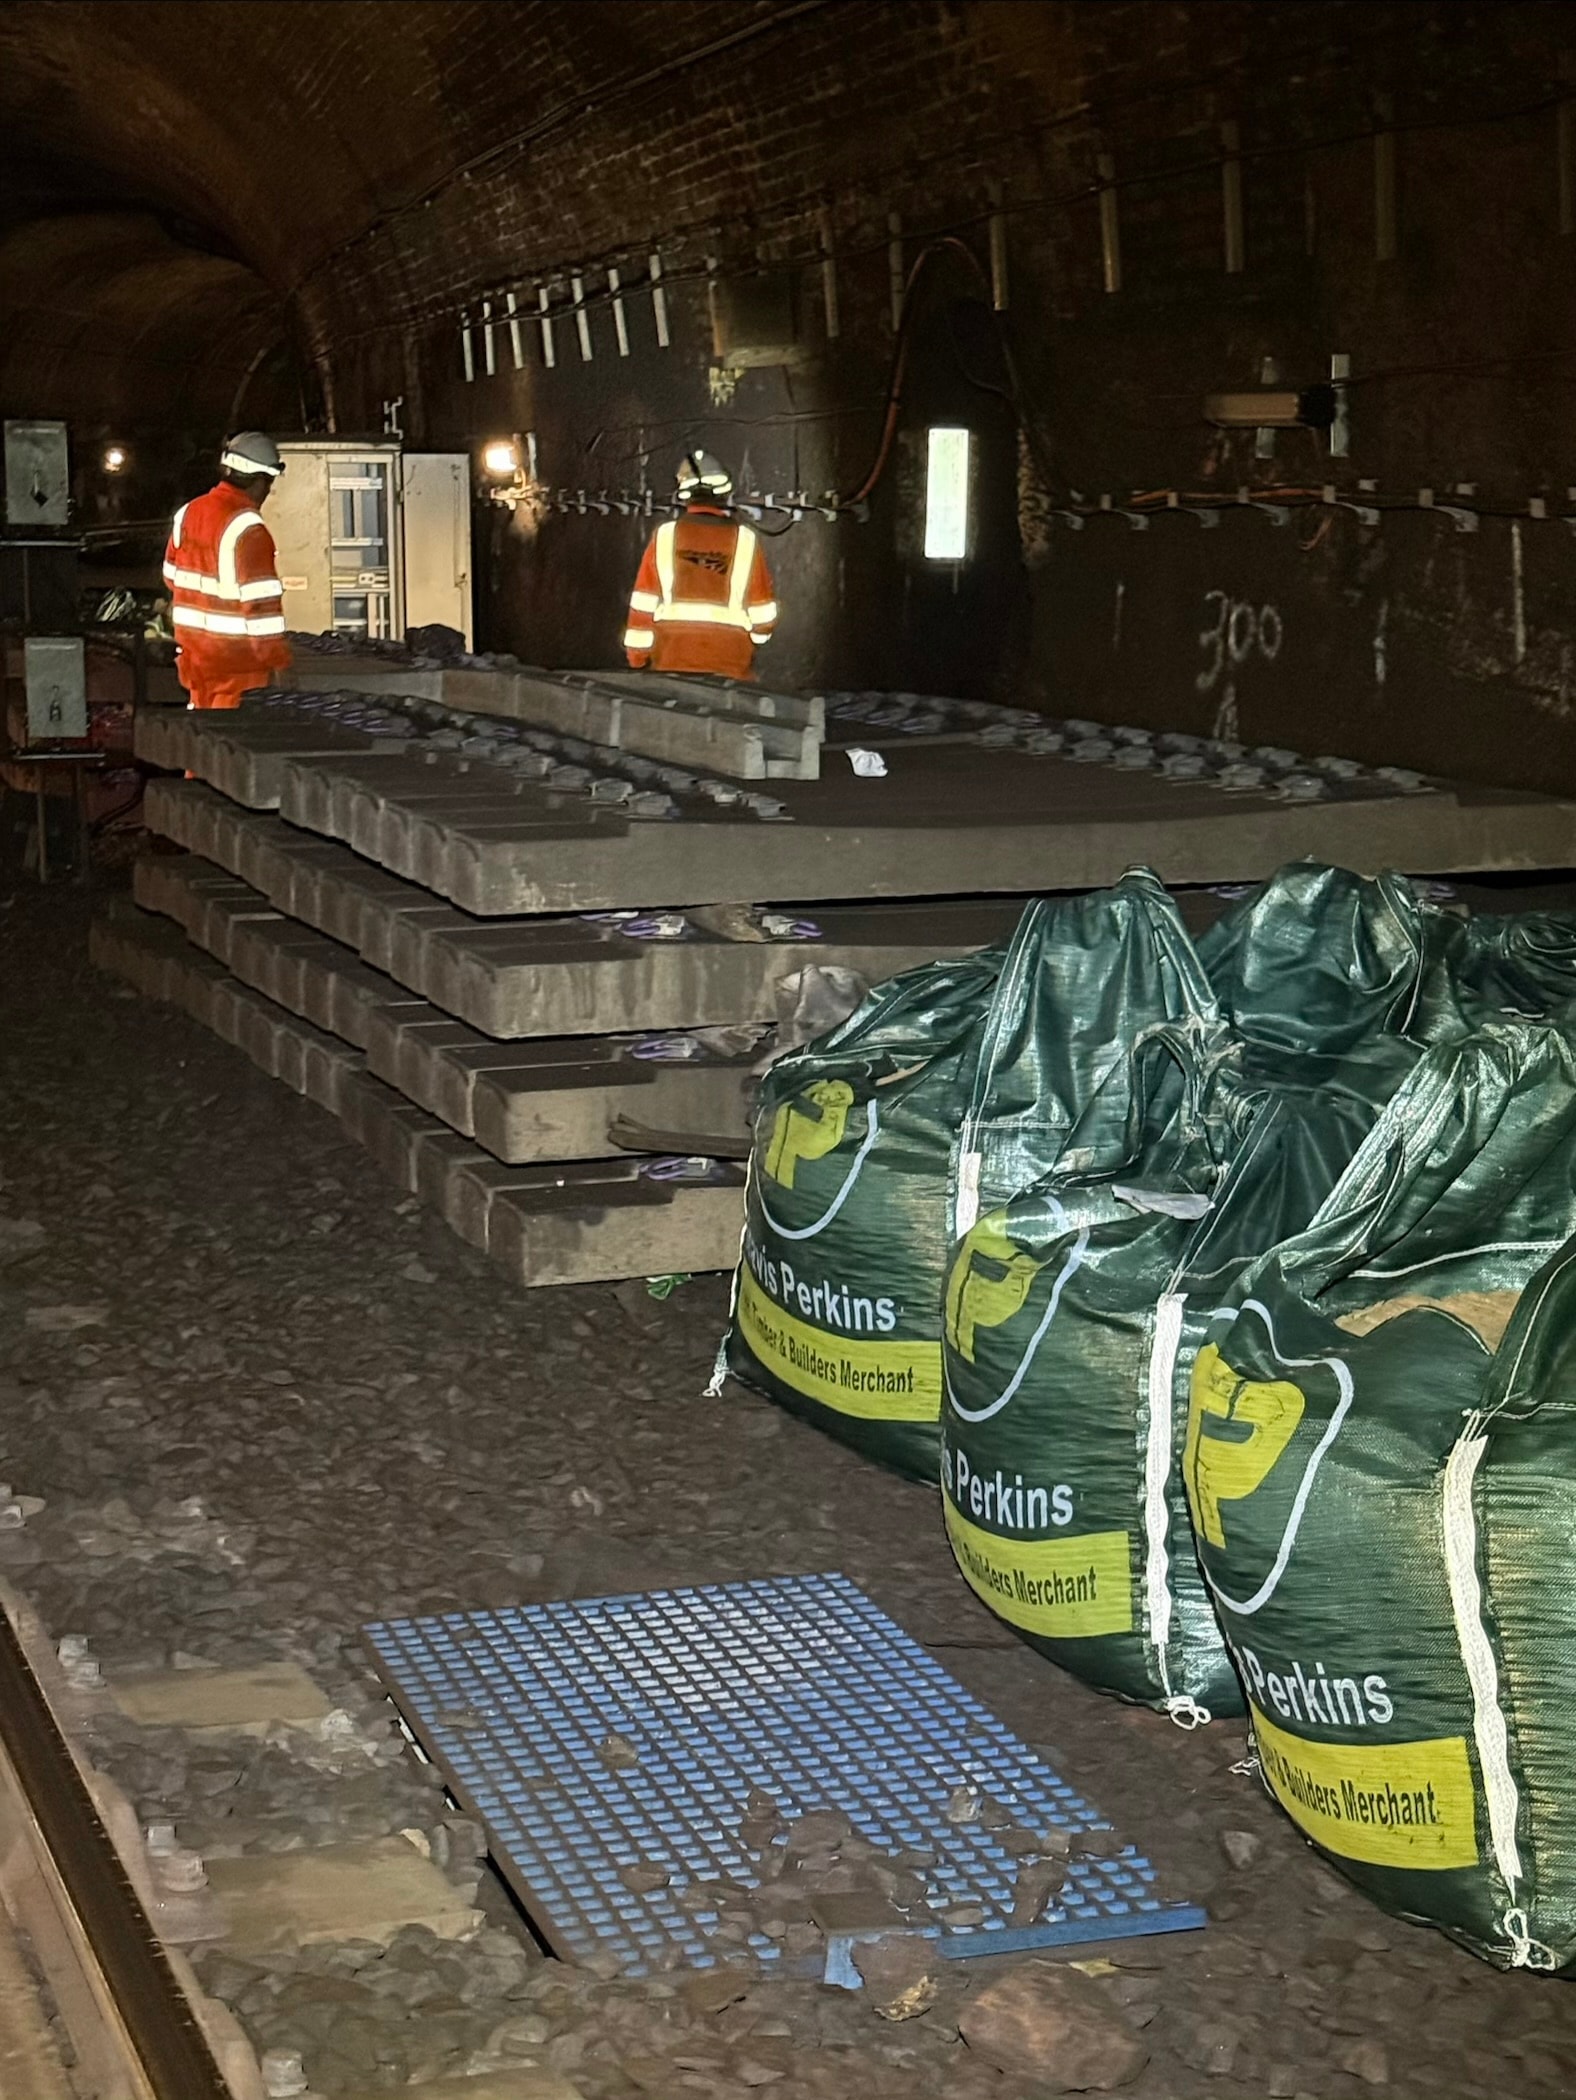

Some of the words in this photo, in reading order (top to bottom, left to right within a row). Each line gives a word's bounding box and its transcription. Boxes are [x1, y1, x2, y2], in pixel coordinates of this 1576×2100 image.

[1196, 590, 1282, 688] 300
[780, 1261, 897, 1332] Perkins
[788, 1335, 838, 1384] Builders
[840, 1359, 914, 1393] Merchant
[956, 1448, 1074, 1529] Perkins
[1012, 1565, 1097, 1606] Merchant
[1241, 1646, 1394, 1724] Perkins
[1281, 1756, 1341, 1819] Builders
[1340, 1779, 1437, 1824] Merchant
